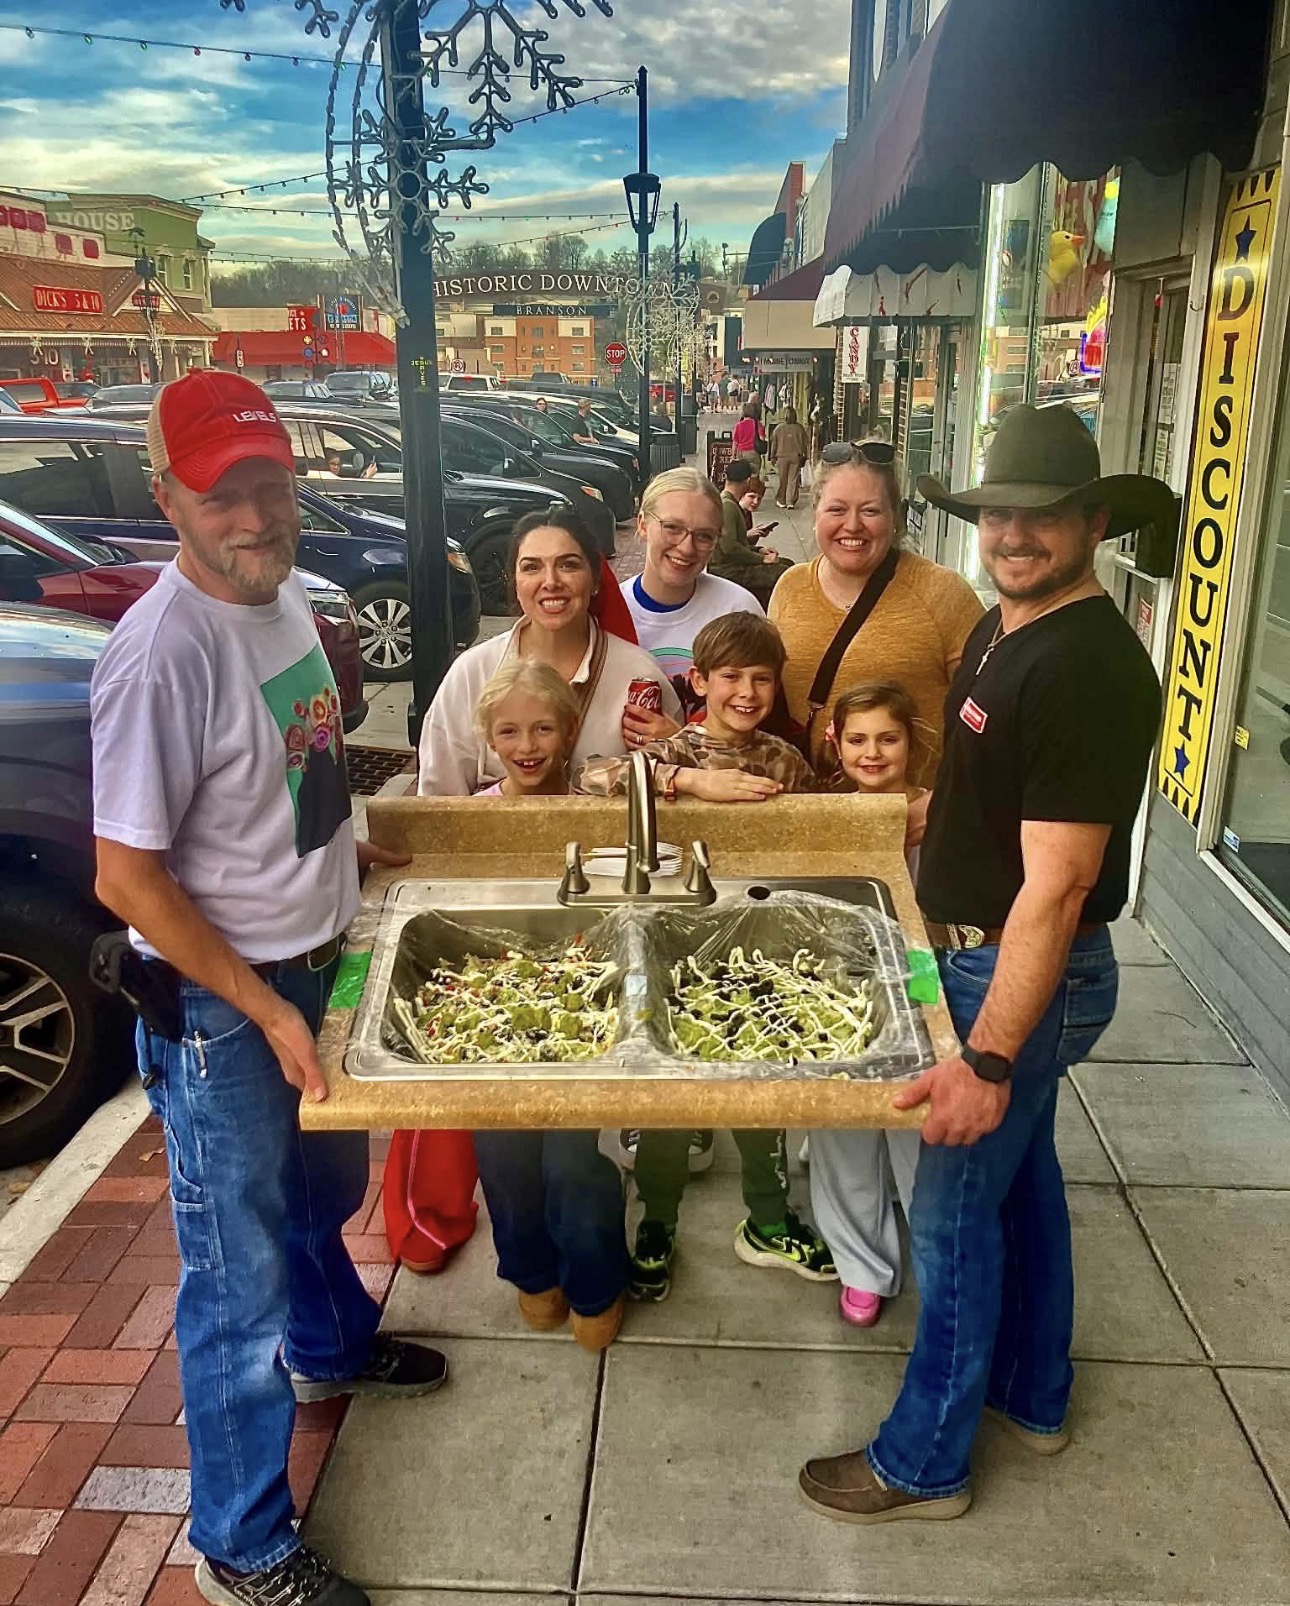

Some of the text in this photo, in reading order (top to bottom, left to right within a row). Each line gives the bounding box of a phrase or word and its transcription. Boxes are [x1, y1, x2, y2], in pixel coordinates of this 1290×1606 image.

[56, 211, 135, 231] HOUSE
[36, 289, 68, 308] DICK'S
[516, 305, 587, 316] BRANSON
[606, 349, 625, 359] STOP
[848, 327, 859, 374] CANDY
[1177, 266, 1255, 742] DISCOUNT
